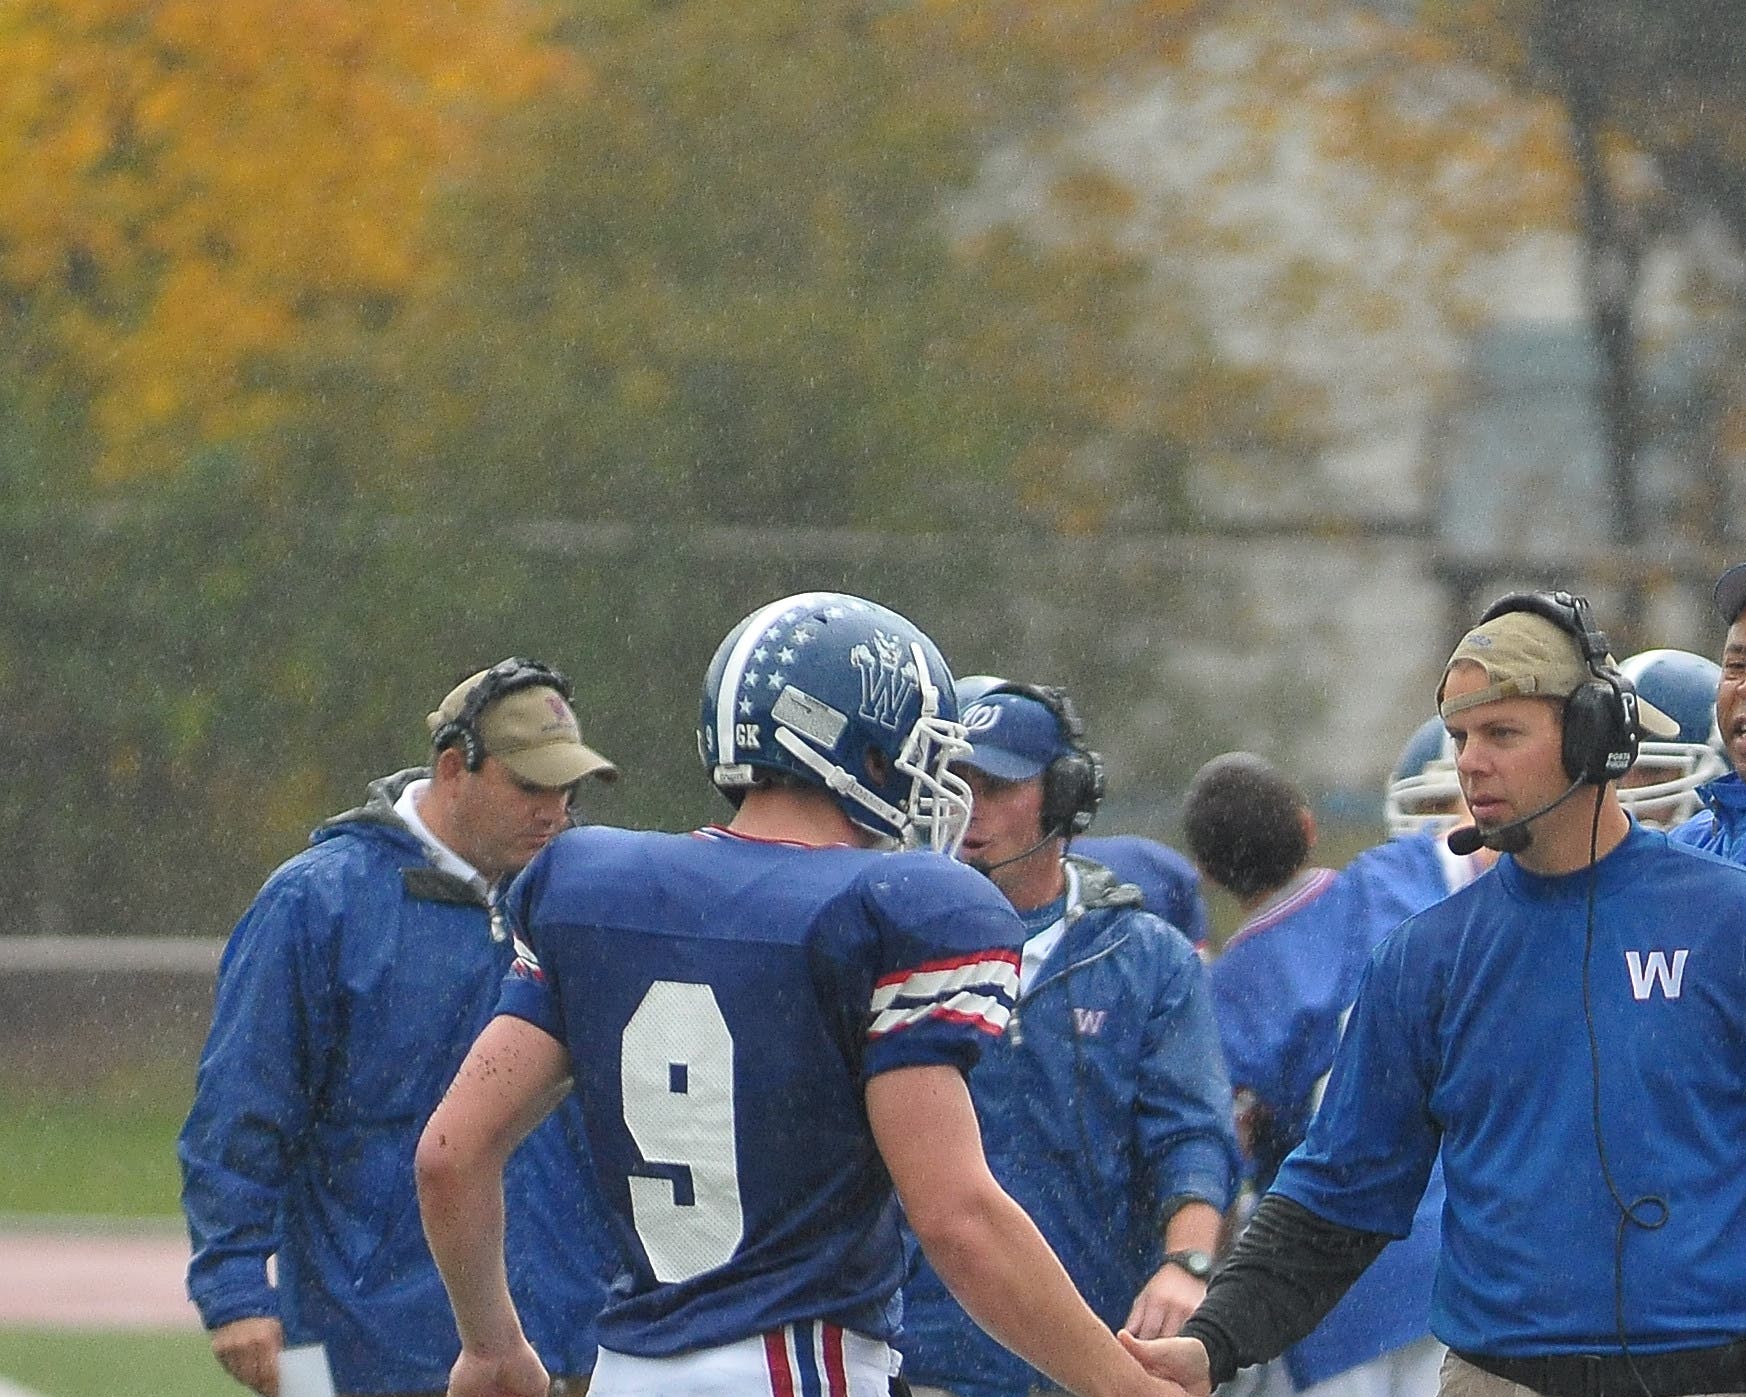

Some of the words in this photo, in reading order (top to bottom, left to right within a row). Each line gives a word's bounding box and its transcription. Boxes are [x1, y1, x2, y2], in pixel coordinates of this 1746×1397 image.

[735, 723, 761, 748] GK
[1625, 949, 1689, 1000] W
[1073, 1007, 1106, 1036] W
[621, 980, 744, 1284] 9
